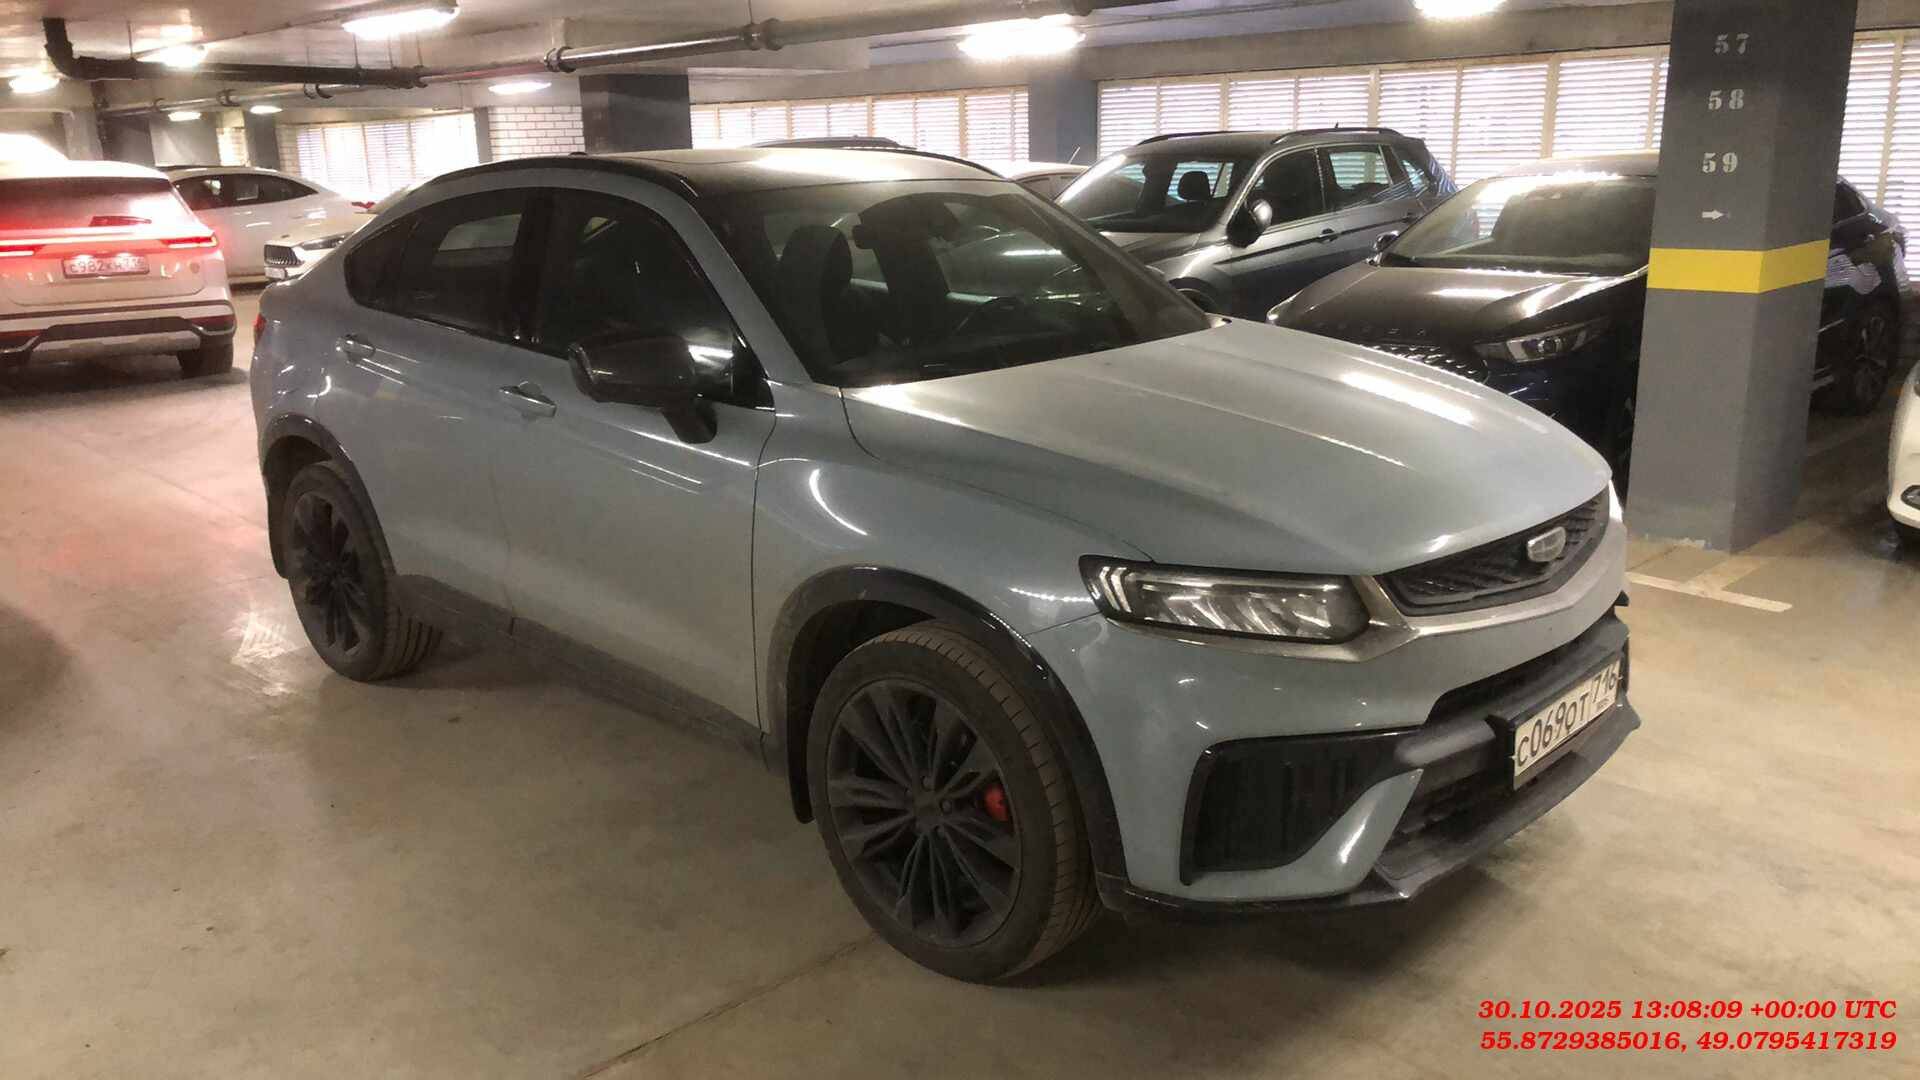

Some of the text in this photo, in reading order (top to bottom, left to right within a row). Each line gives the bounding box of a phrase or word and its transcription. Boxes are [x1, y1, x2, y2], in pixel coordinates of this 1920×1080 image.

[1714, 33, 1750, 54] 57
[1708, 89, 1744, 110] 58
[1702, 152, 1738, 173] 59
